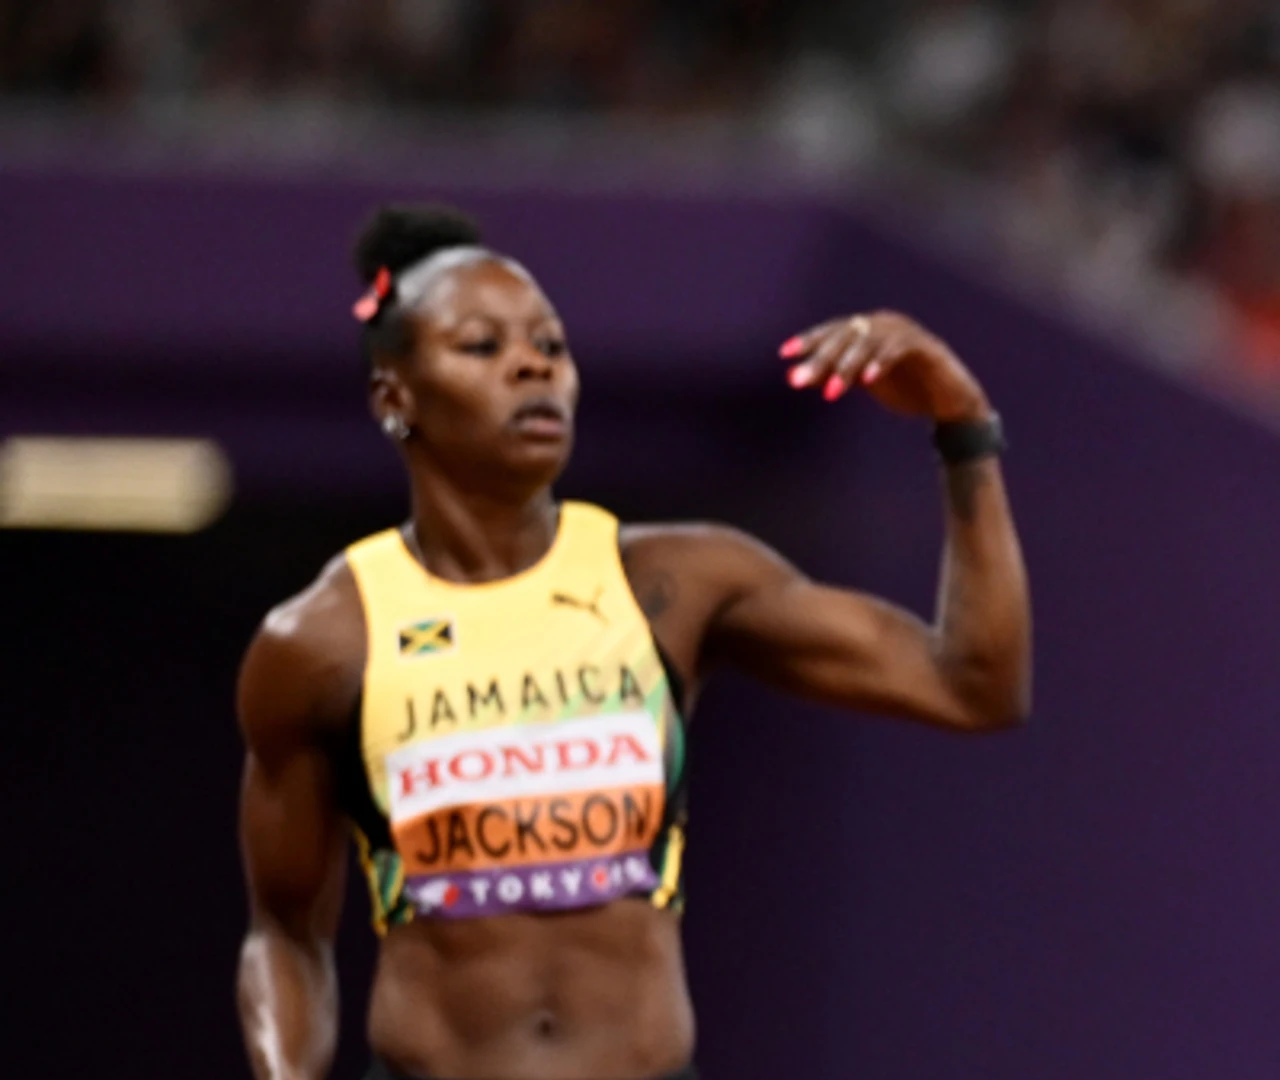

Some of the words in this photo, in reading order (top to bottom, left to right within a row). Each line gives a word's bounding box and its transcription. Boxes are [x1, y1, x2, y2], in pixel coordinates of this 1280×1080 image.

[397, 664, 646, 743] JAMAICA
[399, 732, 652, 798] HONDA
[415, 791, 655, 866] JACKSON
